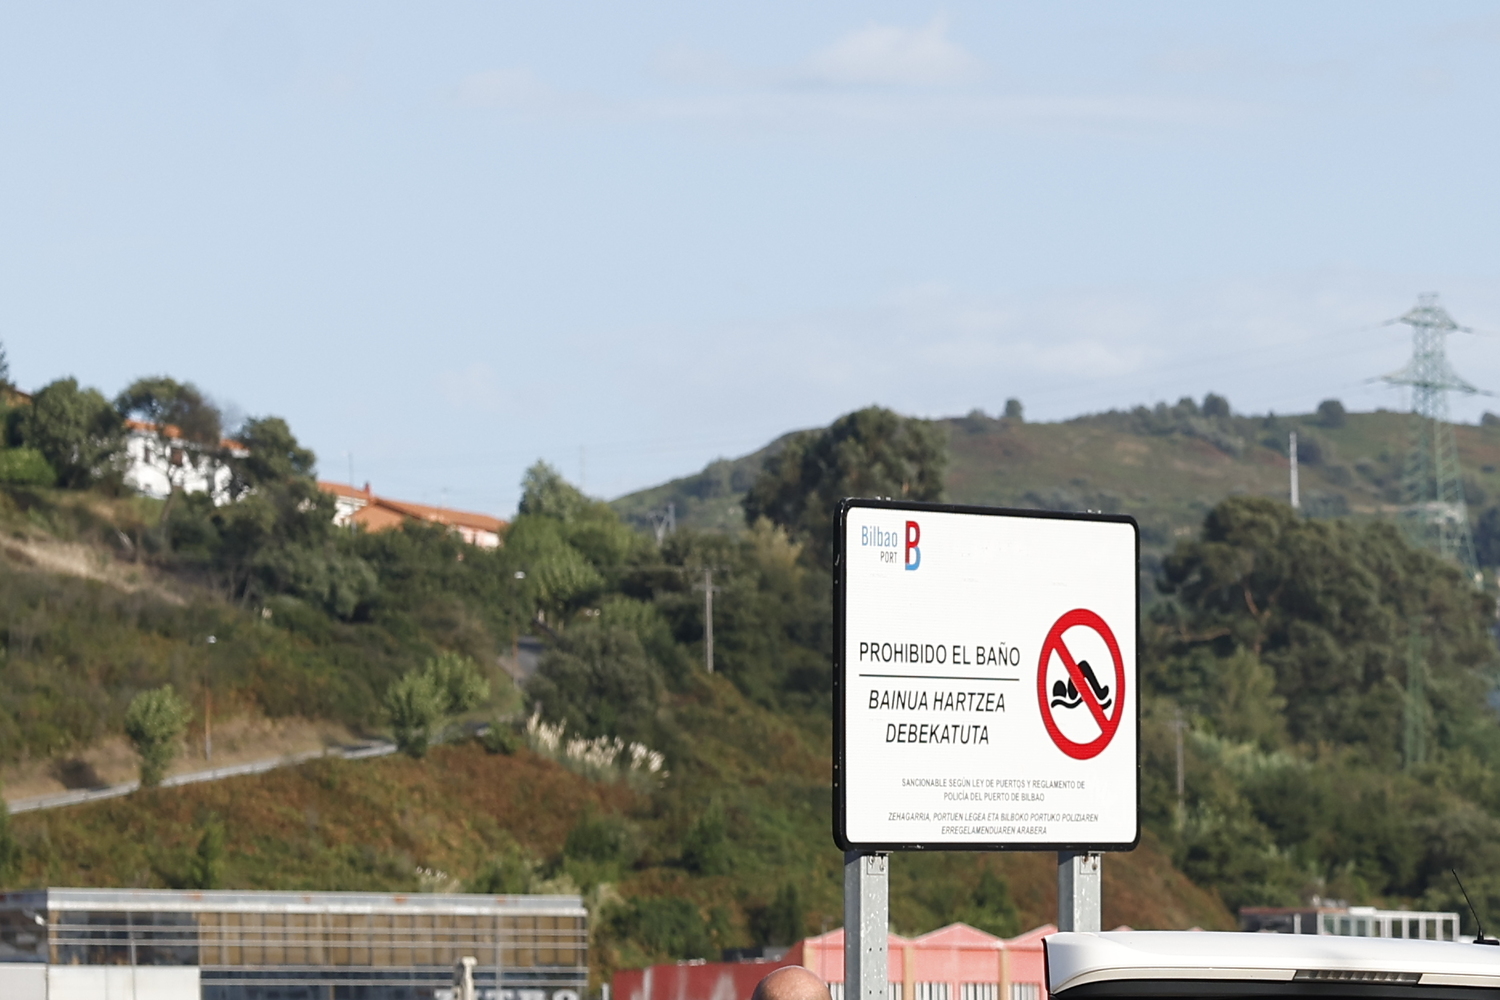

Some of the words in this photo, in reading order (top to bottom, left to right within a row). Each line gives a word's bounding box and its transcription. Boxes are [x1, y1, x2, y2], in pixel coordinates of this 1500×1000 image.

[861, 525, 898, 547] Bilbao
[880, 551, 898, 563] PORT
[859, 642, 947, 664] PROHIBIDO
[952, 645, 971, 665] EL
[976, 641, 1020, 666] BAÑO
[868, 690, 928, 711] BAINUA
[933, 691, 1005, 712] HARTZEA
[885, 723, 989, 745] DEBEKATUTA
[901, 778, 947, 788] SANCIONABLE
[948, 776, 971, 788] SEGÚN
[972, 779, 985, 788] LEY
[986, 779, 995, 788] DE
[996, 779, 1026, 789] PUERTOS
[1027, 780, 1031, 788] Y
[1032, 780, 1076, 789] REGLAMENTO
[1077, 781, 1086, 789] DE
[943, 790, 969, 801] POLICÍA
[970, 792, 983, 801] DEL
[984, 792, 1010, 801] PUERTO
[1011, 793, 1020, 801] DE
[1021, 793, 1045, 802] BILBAO
[933, 812, 964, 821] PORTUEN
[965, 812, 986, 821] LEGEA
[987, 813, 1000, 821] ETA
[1000, 813, 1029, 822] BILBOKO
[1030, 813, 1061, 822] PORTUKO
[1062, 813, 1099, 822] POLIZIAREN
[941, 826, 1016, 835] ERREGELAMENDUAREN
[1017, 826, 1047, 835] ARABERA
